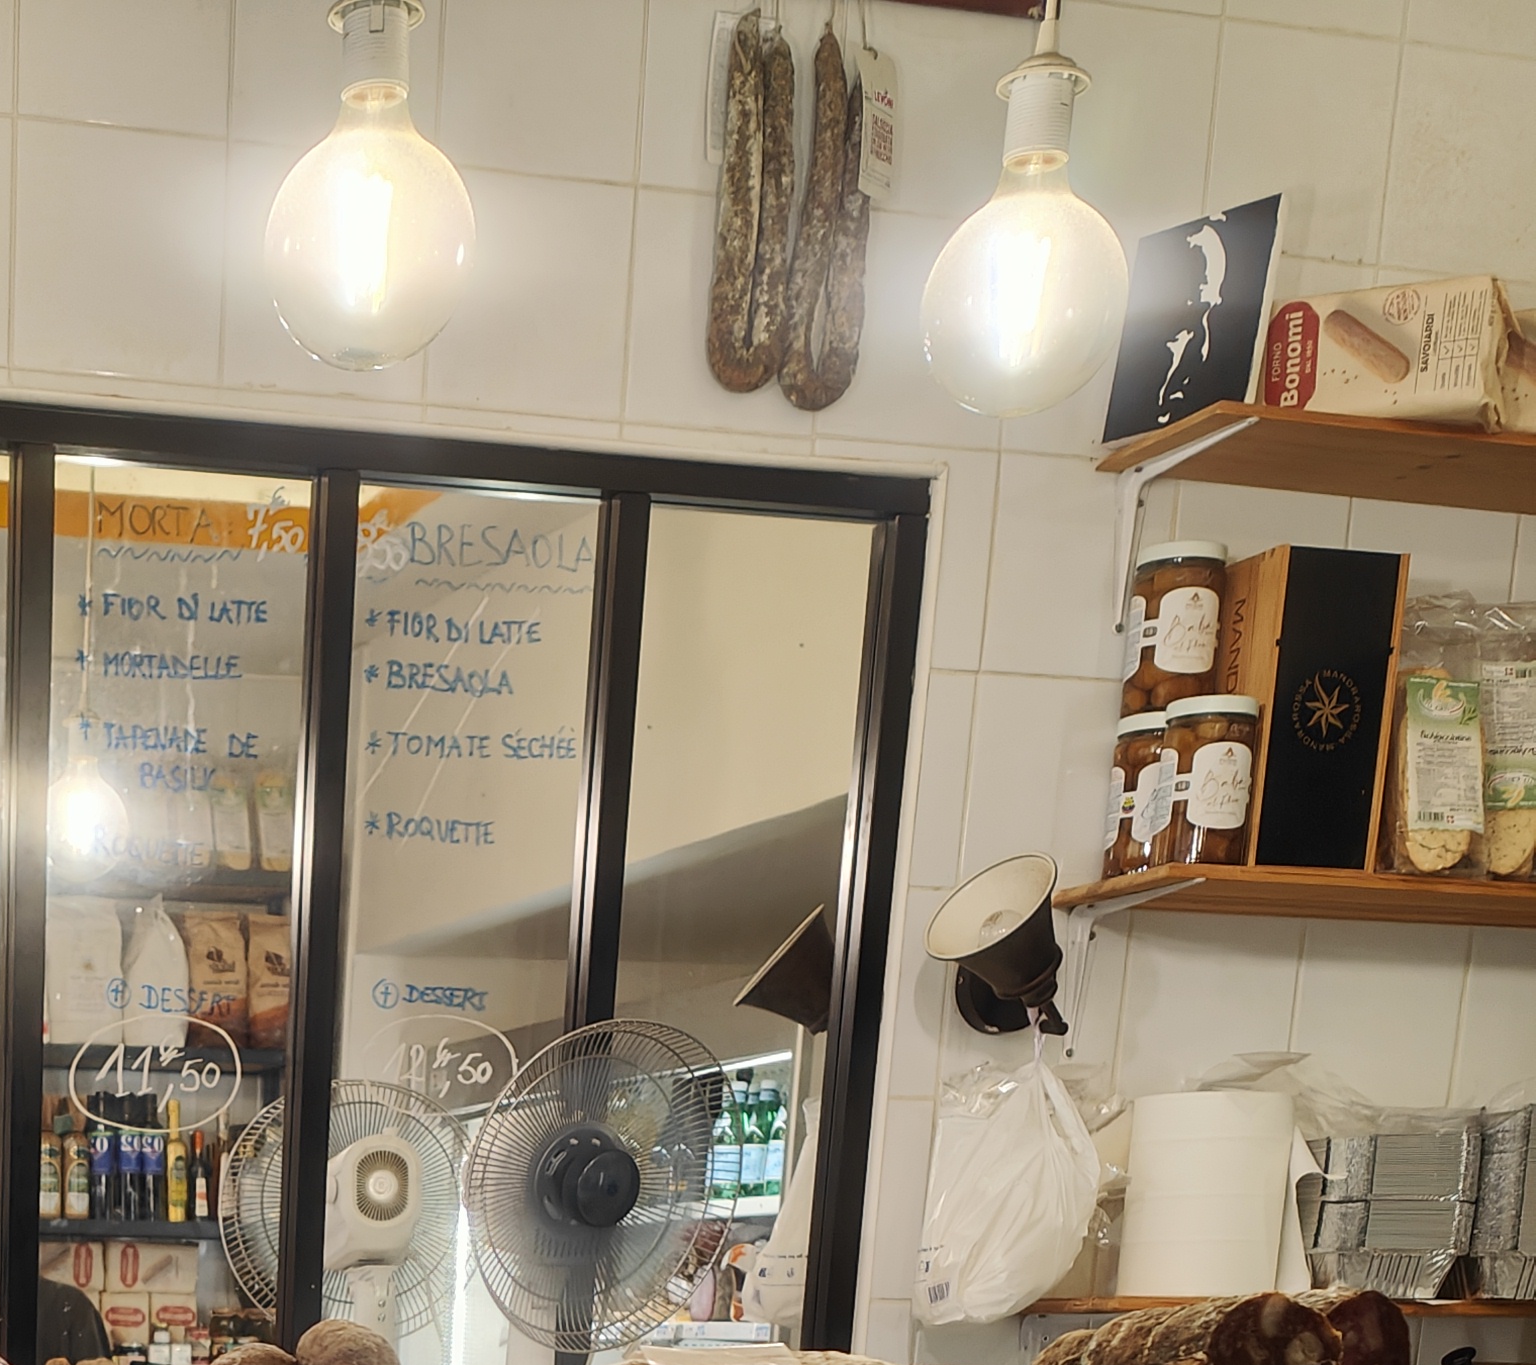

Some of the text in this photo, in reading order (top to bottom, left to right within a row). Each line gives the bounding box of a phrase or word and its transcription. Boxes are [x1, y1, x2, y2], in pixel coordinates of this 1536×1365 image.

[1278, 309, 1306, 408] Bonomi
[1419, 312, 1435, 374] SAVOIARDI
[1272, 341, 1282, 383] FORNO
[408, 520, 593, 573] BRESAOLA
[102, 592, 166, 621] FIOR
[208, 598, 268, 625] LATTE
[386, 610, 439, 644] FIOR
[479, 617, 542, 645] LATTE
[101, 653, 242, 680] MORTADELLE
[385, 662, 515, 696] BRESAOLA
[102, 720, 260, 759] TAPENADE DE
[388, 730, 491, 759] TOMATE
[386, 812, 497, 845] ROQUETTE
